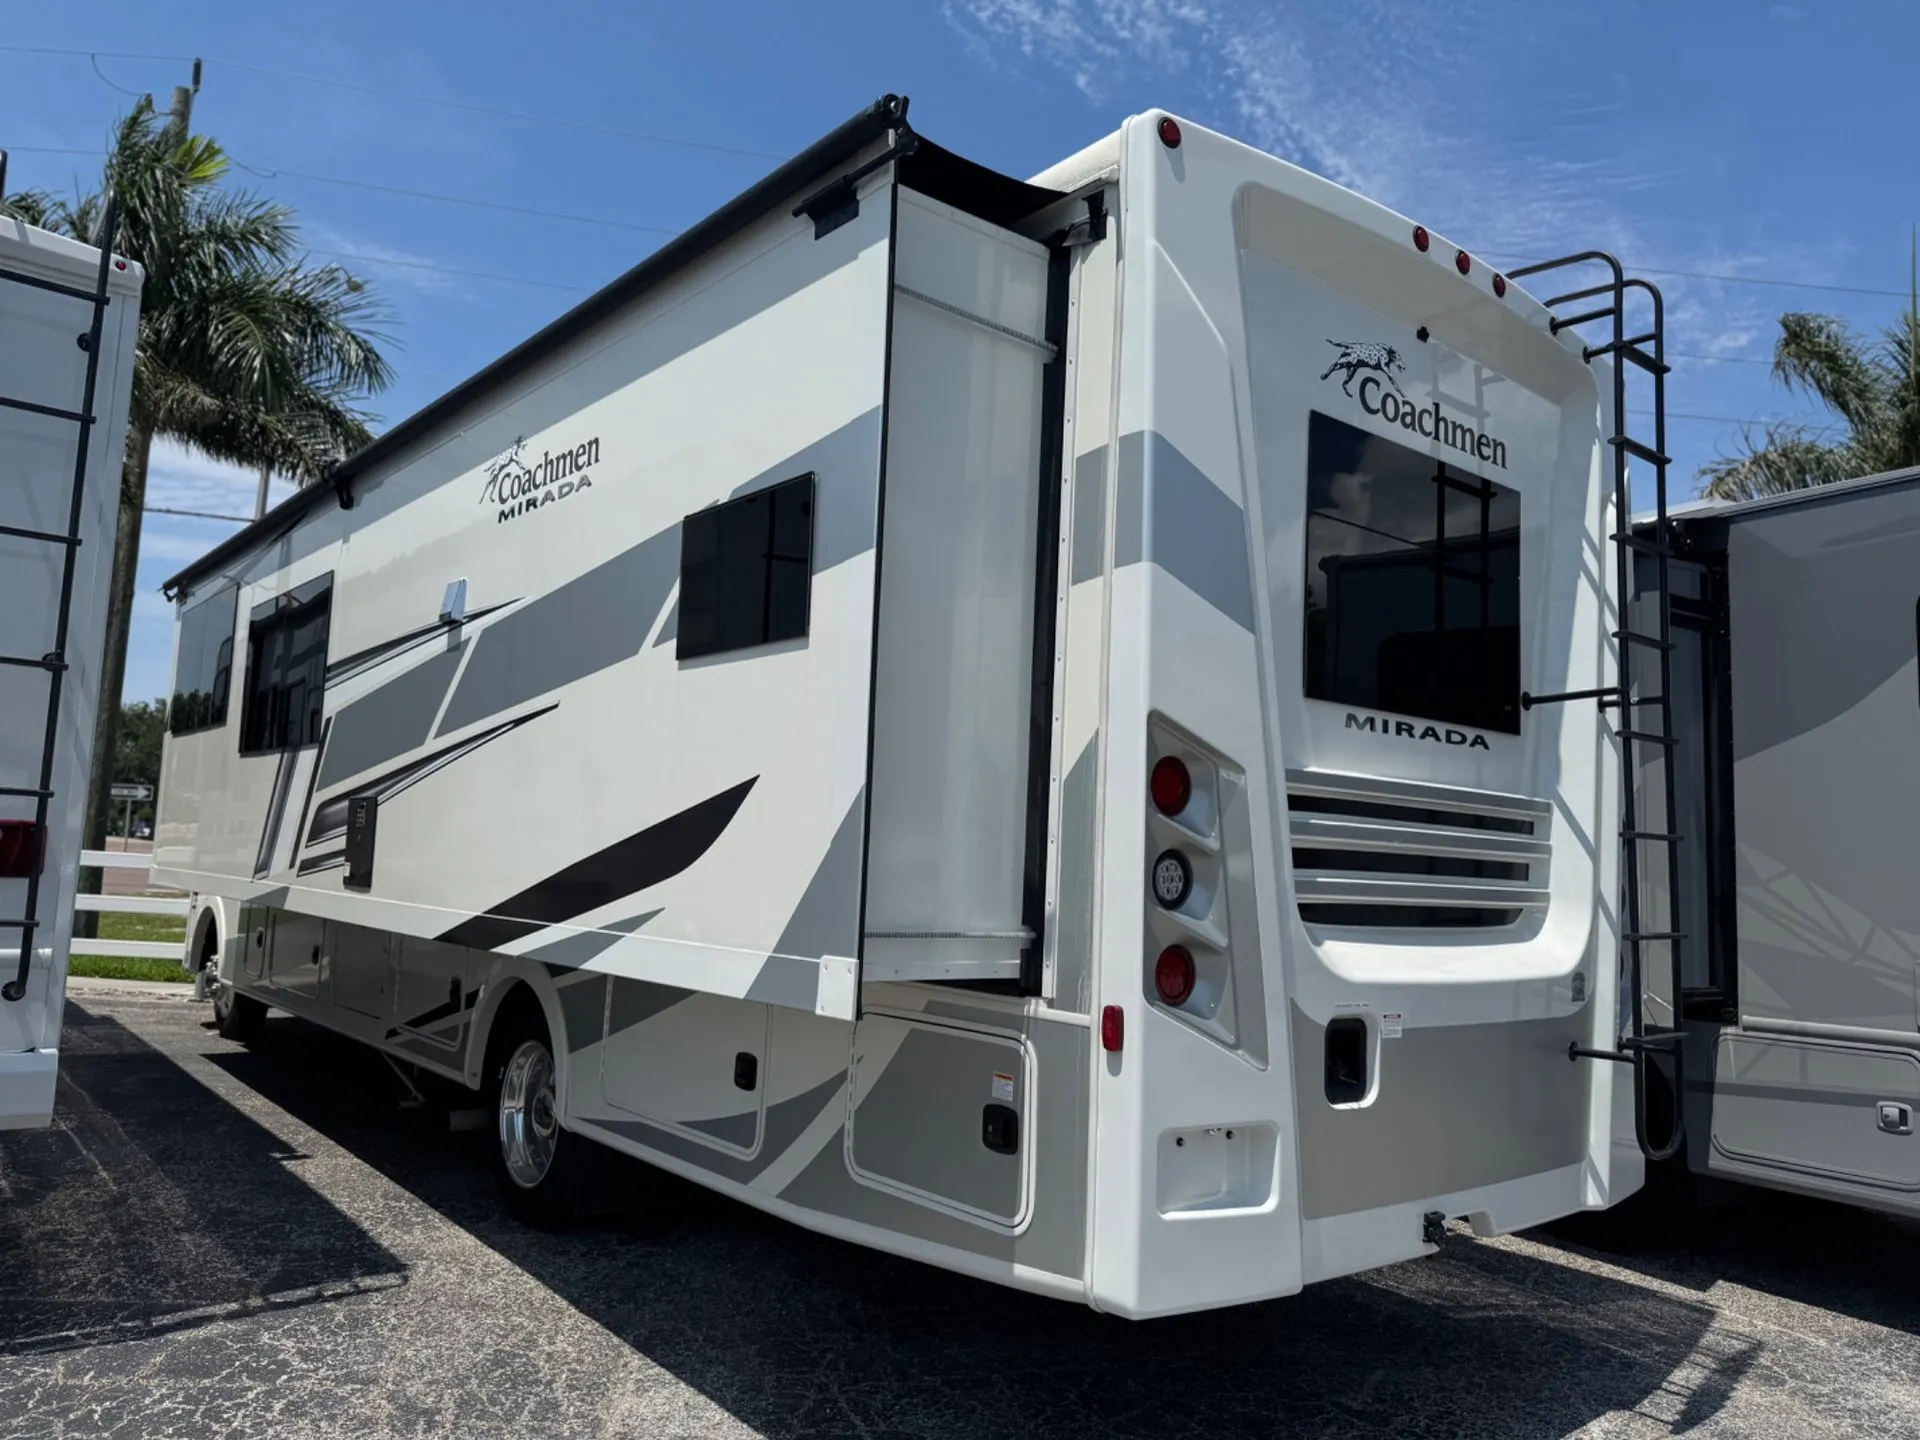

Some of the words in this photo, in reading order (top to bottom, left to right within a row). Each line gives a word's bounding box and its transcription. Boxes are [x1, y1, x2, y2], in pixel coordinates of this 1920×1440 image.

[1358, 375, 1508, 470] Coachmen
[497, 436, 600, 505] Coachmen
[497, 474, 592, 524] MIRADA
[1345, 712, 1490, 750] MIRADA
